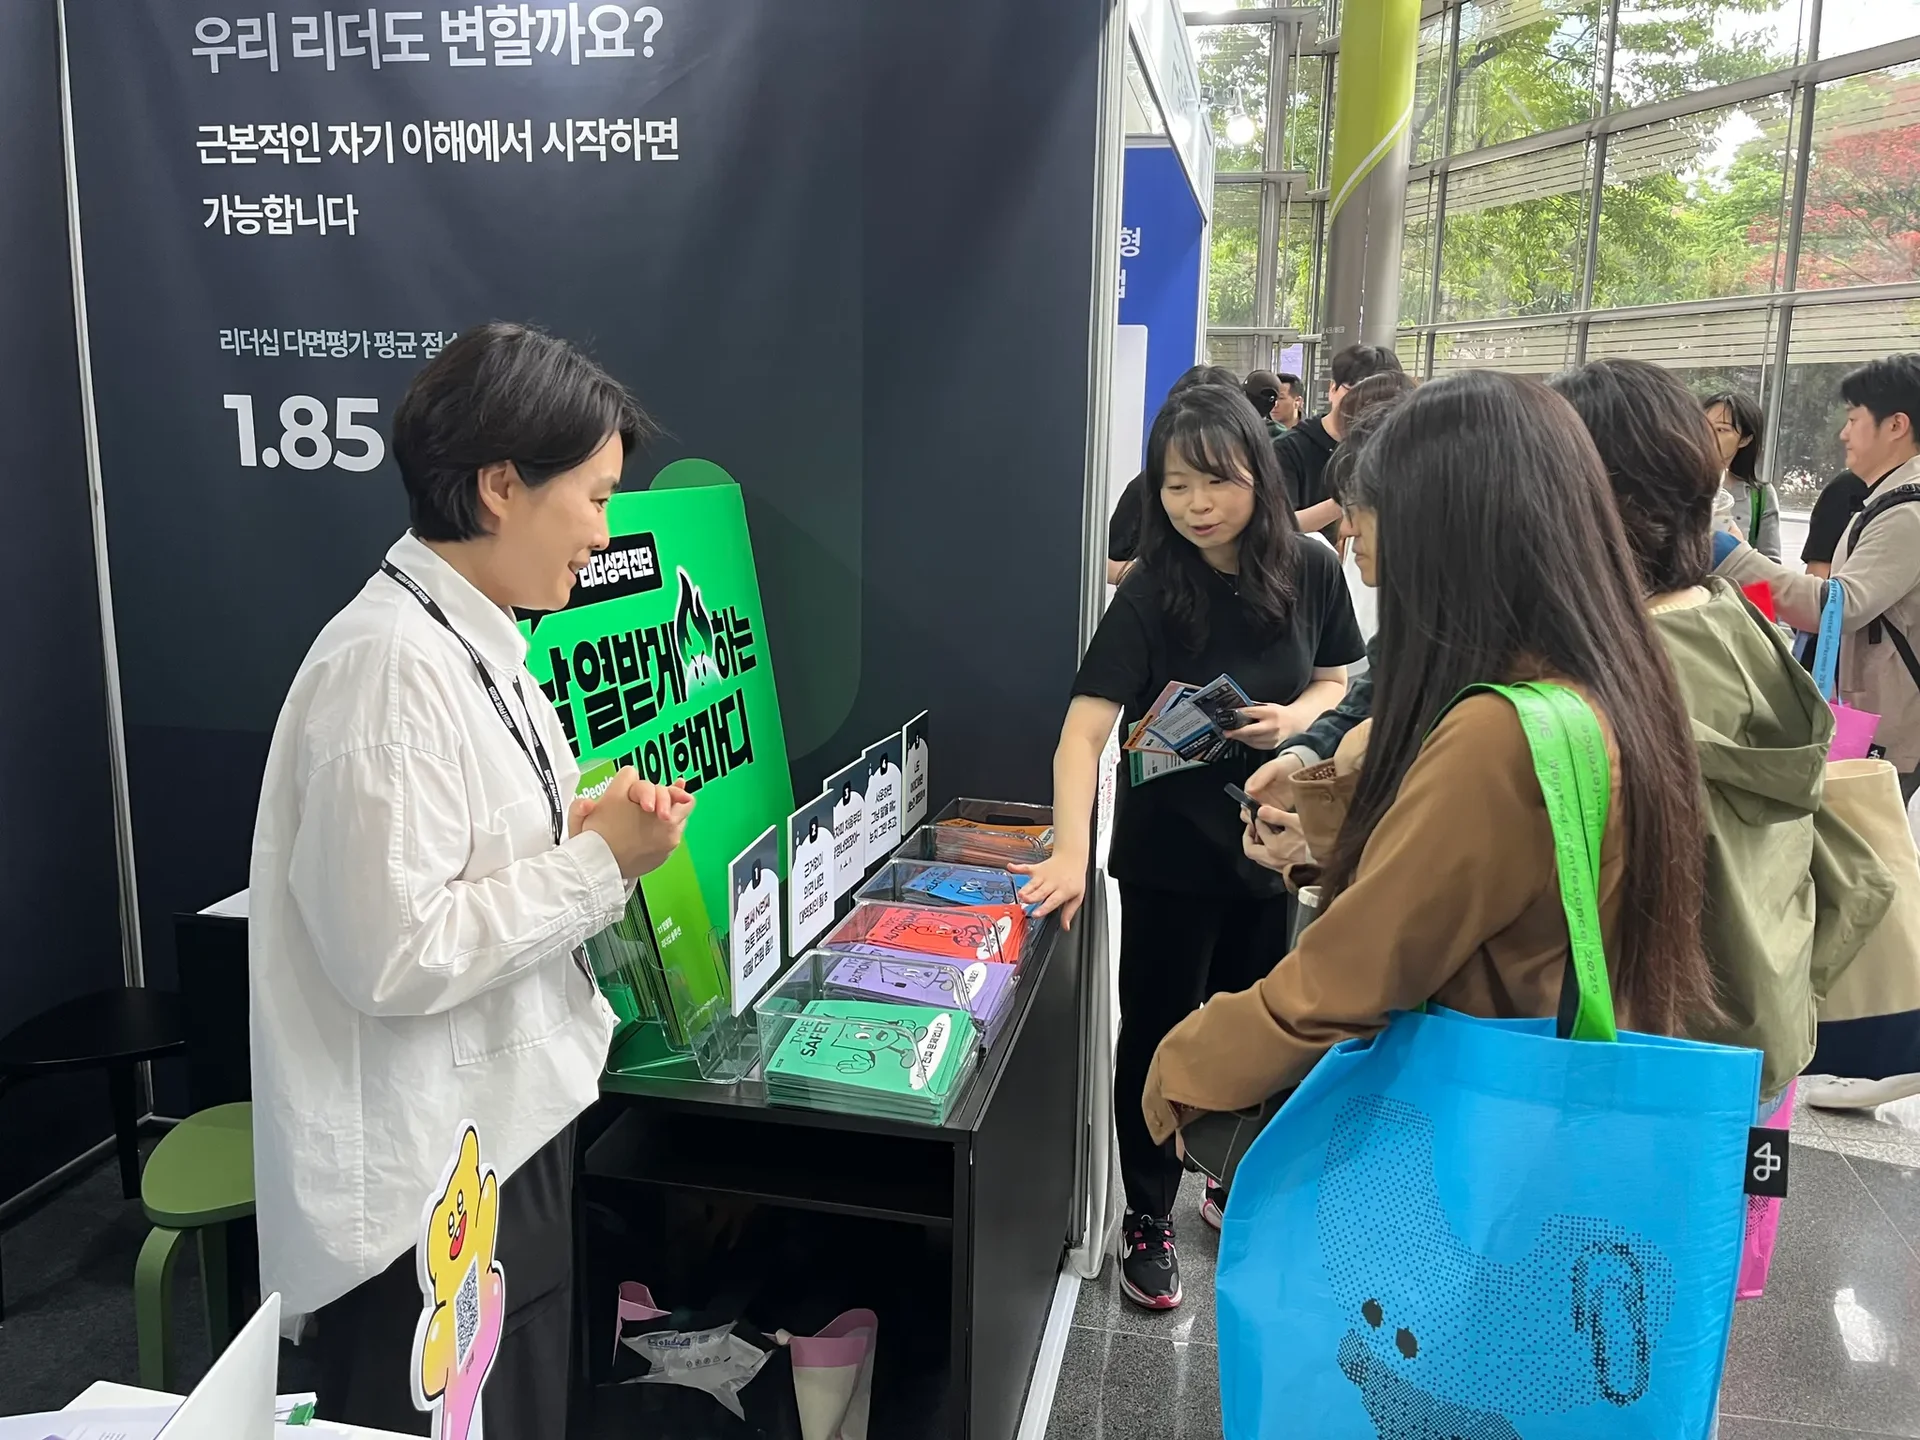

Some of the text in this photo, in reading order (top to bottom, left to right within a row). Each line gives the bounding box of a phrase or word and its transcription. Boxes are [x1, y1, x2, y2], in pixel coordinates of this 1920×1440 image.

[191, 2, 664, 74] 우리 리더도 변할까요?
[196, 117, 679, 164] 근본적인 자기 이해에서 시작하면
[202, 193, 359, 236] 가능합니다
[219, 327, 280, 357] 리더십
[283, 328, 371, 359] 다면평가
[373, 330, 418, 359] 평균
[223, 394, 385, 472] 1.85
[572, 620, 689, 750] 열받게
[710, 605, 758, 680] 하는
[668, 687, 755, 795] 한마디
[789, 1020, 814, 1045] TYPE
